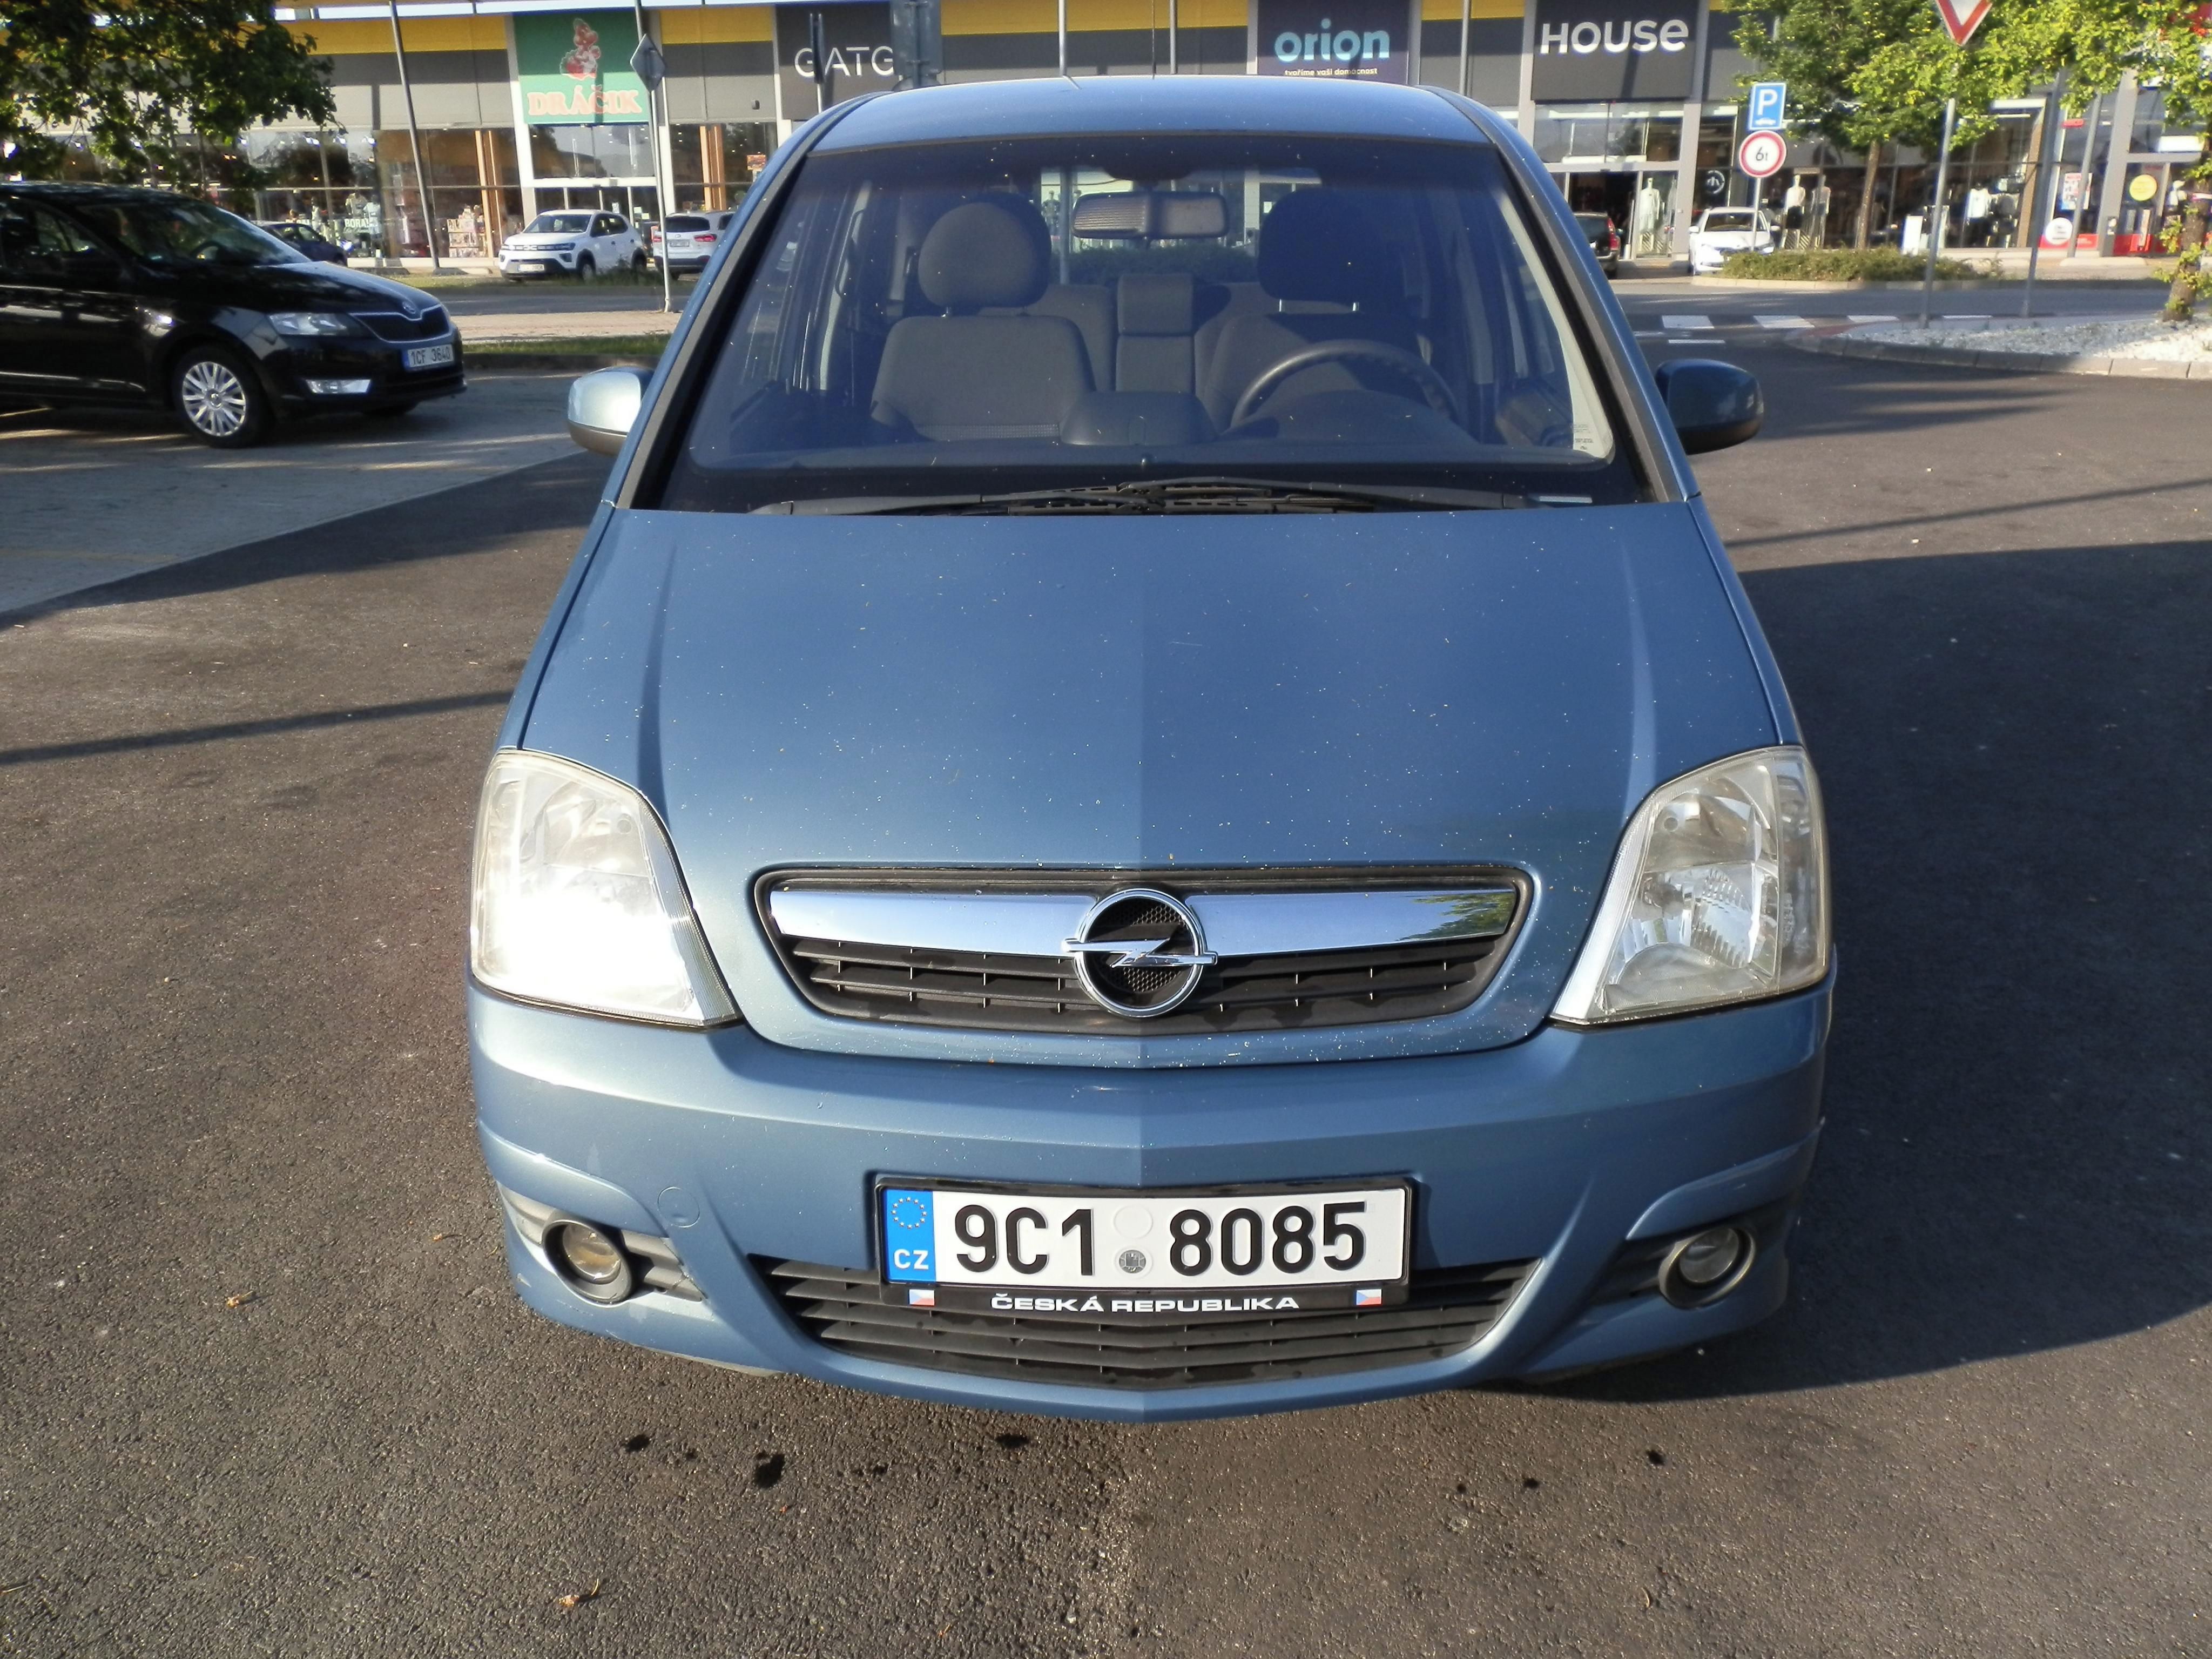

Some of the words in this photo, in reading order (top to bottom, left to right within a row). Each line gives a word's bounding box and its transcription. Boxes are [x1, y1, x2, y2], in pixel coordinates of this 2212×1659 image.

[1274, 18, 1390, 62] orion
[527, 84, 643, 116] DRÁČIK
[1757, 89, 1778, 116] P
[955, 1204, 1094, 1276] 9C1
[1169, 1201, 1366, 1277] 8085
[894, 1249, 929, 1270] CZ
[992, 1293, 1104, 1312] ČESKÁ
[1111, 1297, 1300, 1312] REPUBLIKA
